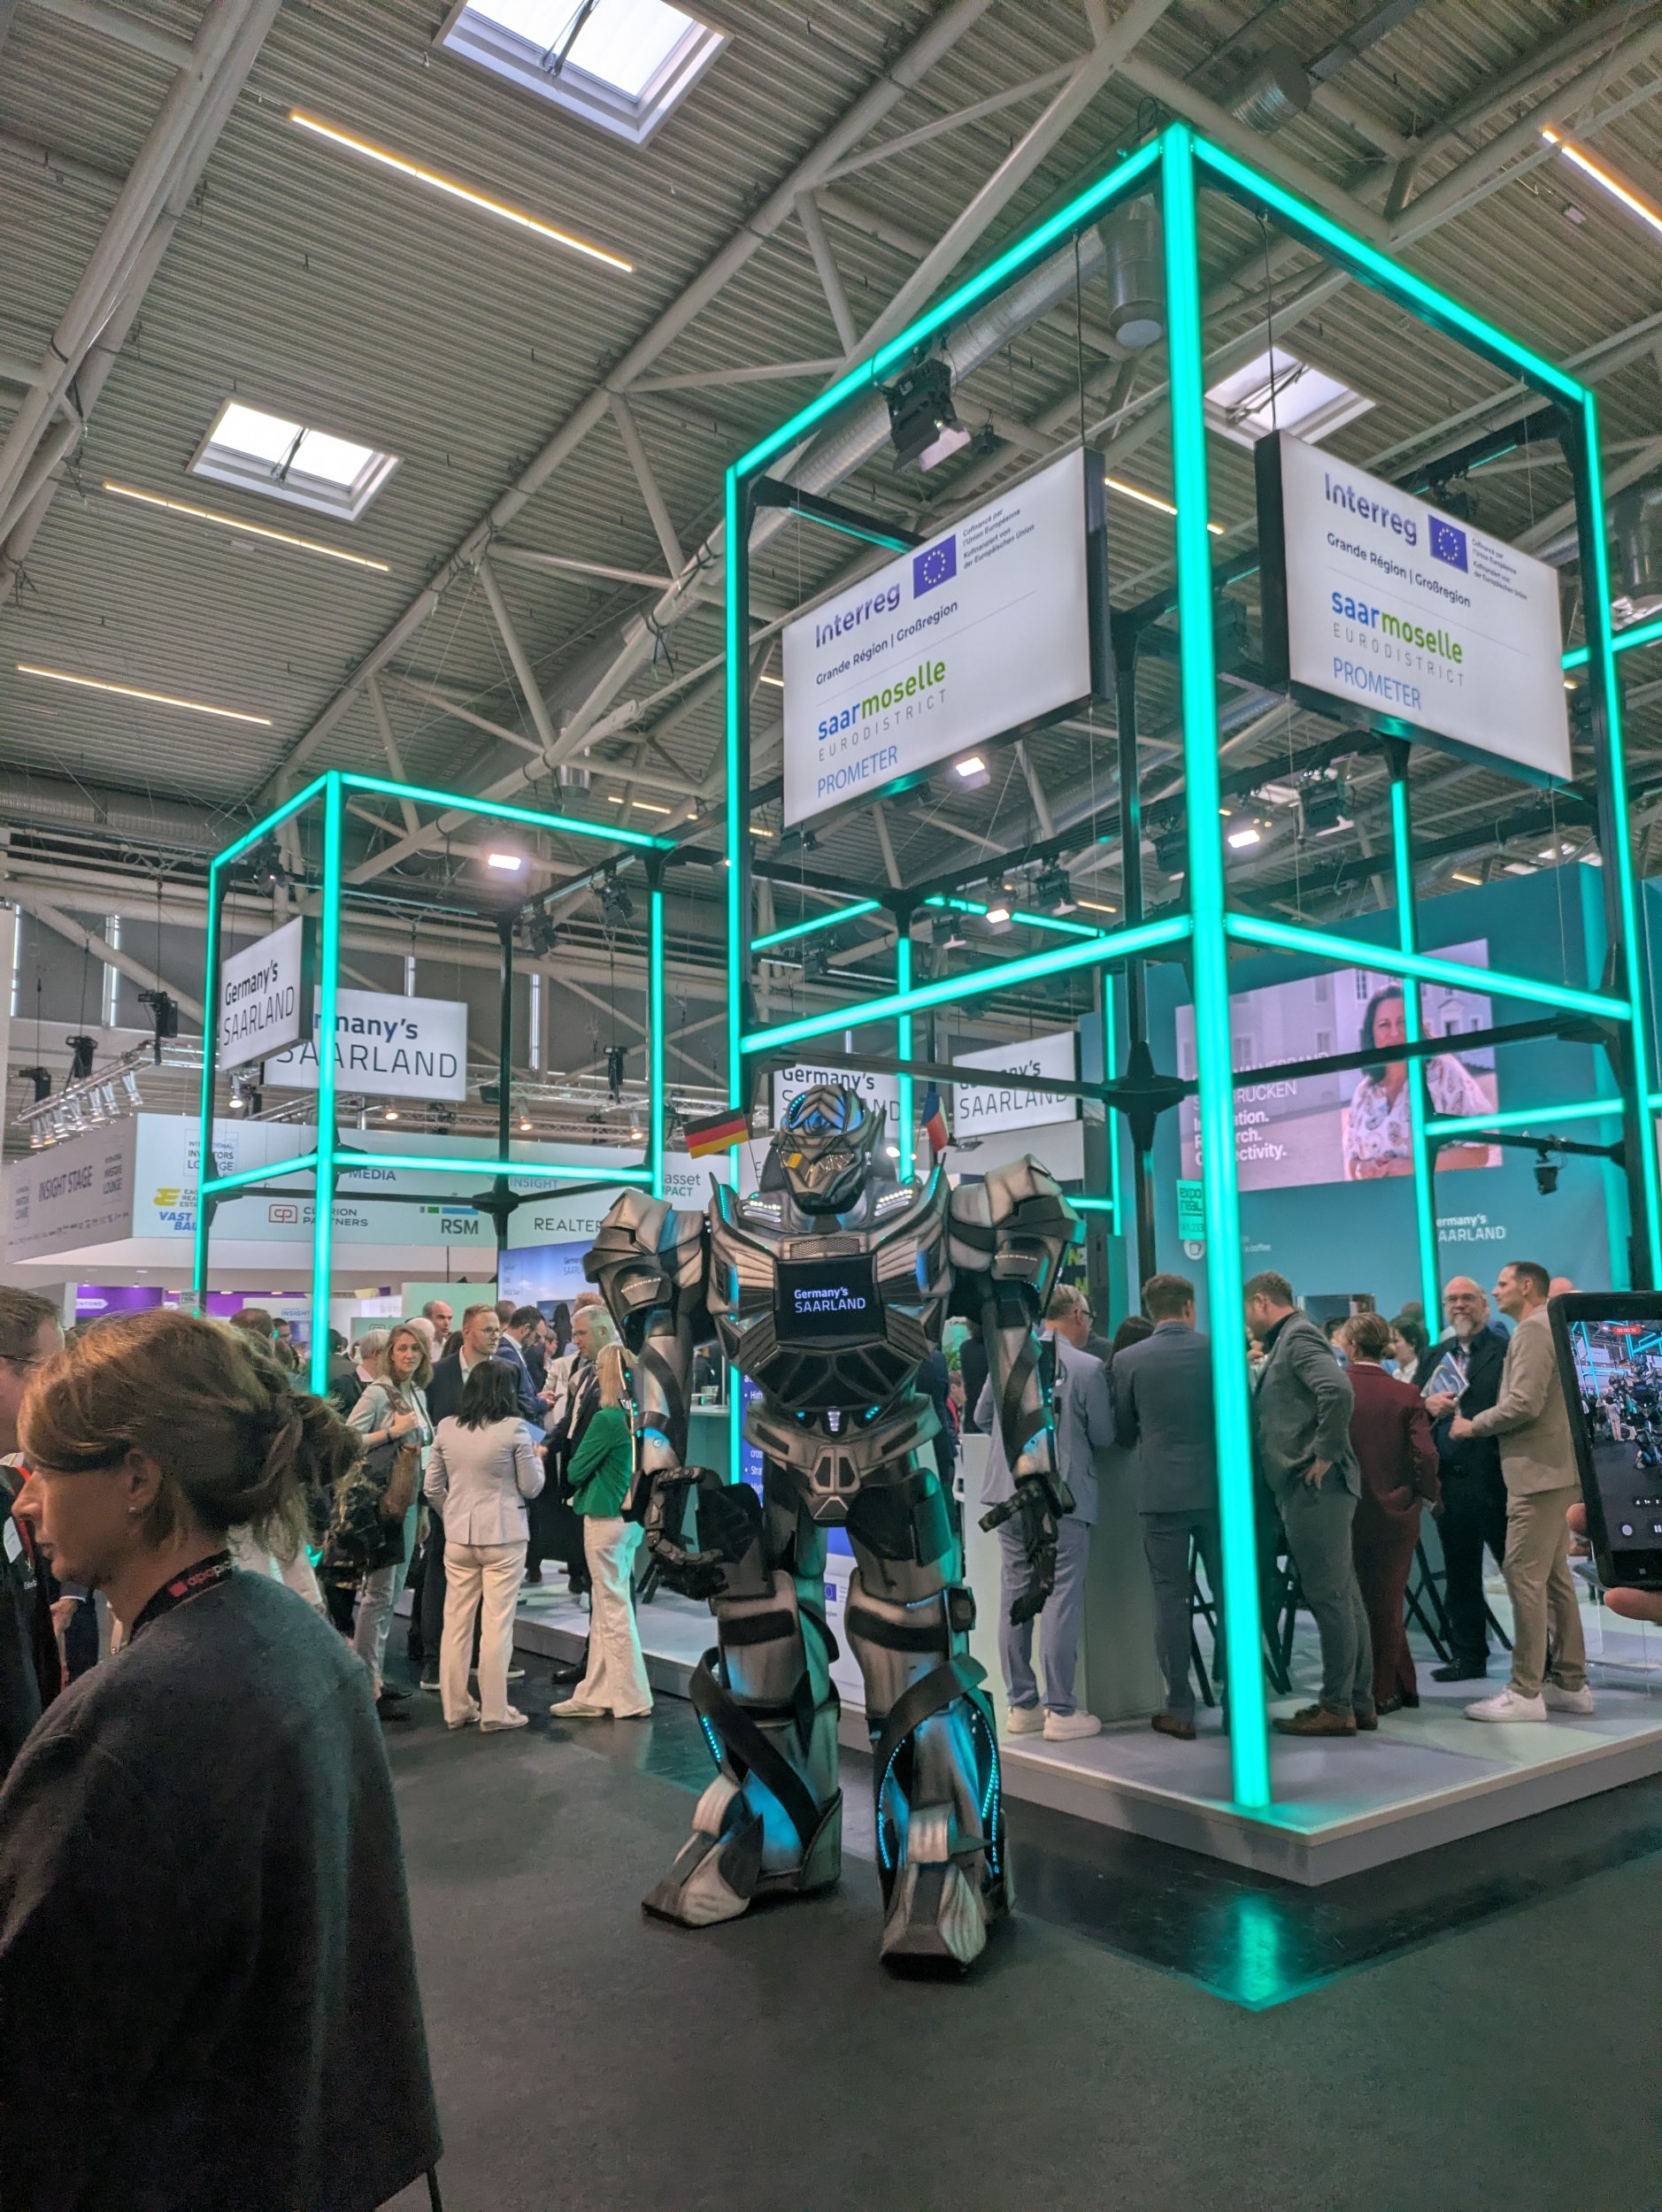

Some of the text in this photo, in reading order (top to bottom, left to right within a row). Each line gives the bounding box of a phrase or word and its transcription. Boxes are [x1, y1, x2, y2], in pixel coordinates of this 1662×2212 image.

[1325, 473, 1417, 546] Interreg
[1327, 533, 1367, 561] Grande
[1370, 552, 1407, 580] Région
[1415, 573, 1471, 608] Großregion
[816, 583, 901, 649] Interreg
[1331, 591, 1463, 664] saarmoselle
[816, 659, 851, 686] Grande
[852, 637, 889, 667] Région
[896, 600, 958, 641] Großregion
[1333, 623, 1464, 687] EURODISTRICT
[1333, 657, 1421, 710] PROMETER
[818, 659, 946, 741] saarmoselle
[819, 688, 947, 762] EURODISTRICT
[817, 745, 898, 798] PROMETER
[225, 959, 279, 1006] Germany's
[223, 986, 295, 1046] SAARLAND
[313, 1012, 418, 1042] rmany's
[68, 1165, 92, 1194] STAGE
[187, 1160, 234, 1171] LOGE
[349, 1169, 396, 1181] MEDIA
[664, 1173, 701, 1187] asset
[510, 1178, 558, 1189] INSIGHT
[665, 1187, 693, 1197] PACT
[158, 1211, 192, 1221] VAST
[303, 1207, 358, 1217] CLRION
[303, 1217, 368, 1227] PANERS
[441, 1218, 479, 1235] RSM
[1435, 1213, 1487, 1227] ermany's
[1438, 1225, 1506, 1242] AARLAND
[794, 1286, 849, 1300] Germany's
[795, 1297, 866, 1313] SAARLAND
